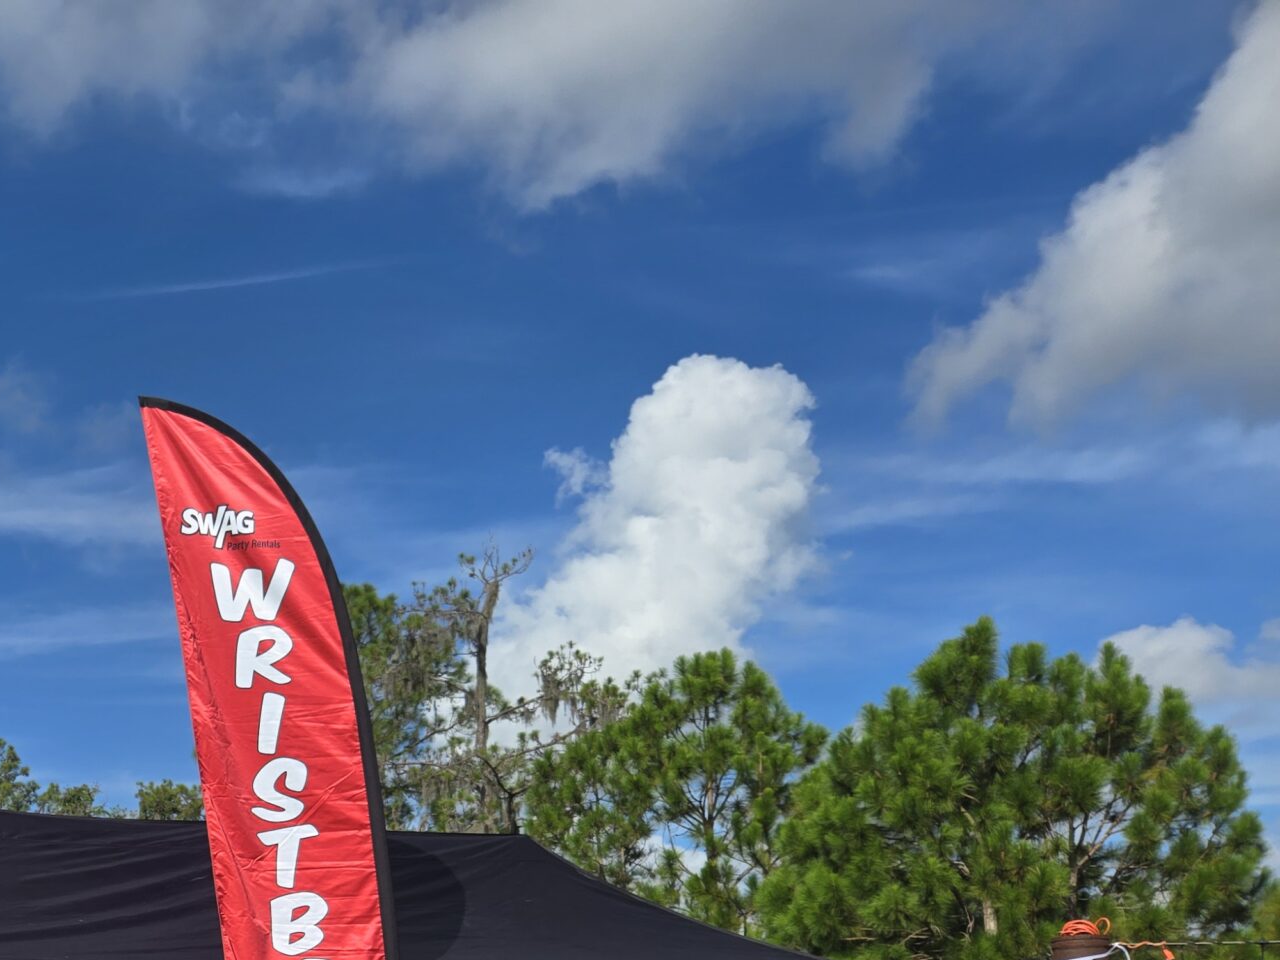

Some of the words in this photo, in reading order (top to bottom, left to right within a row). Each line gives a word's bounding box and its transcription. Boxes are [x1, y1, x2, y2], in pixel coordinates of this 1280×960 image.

[180, 503, 256, 549] SWAG
[227, 541, 250, 551] Party
[251, 539, 281, 549] Rentals
